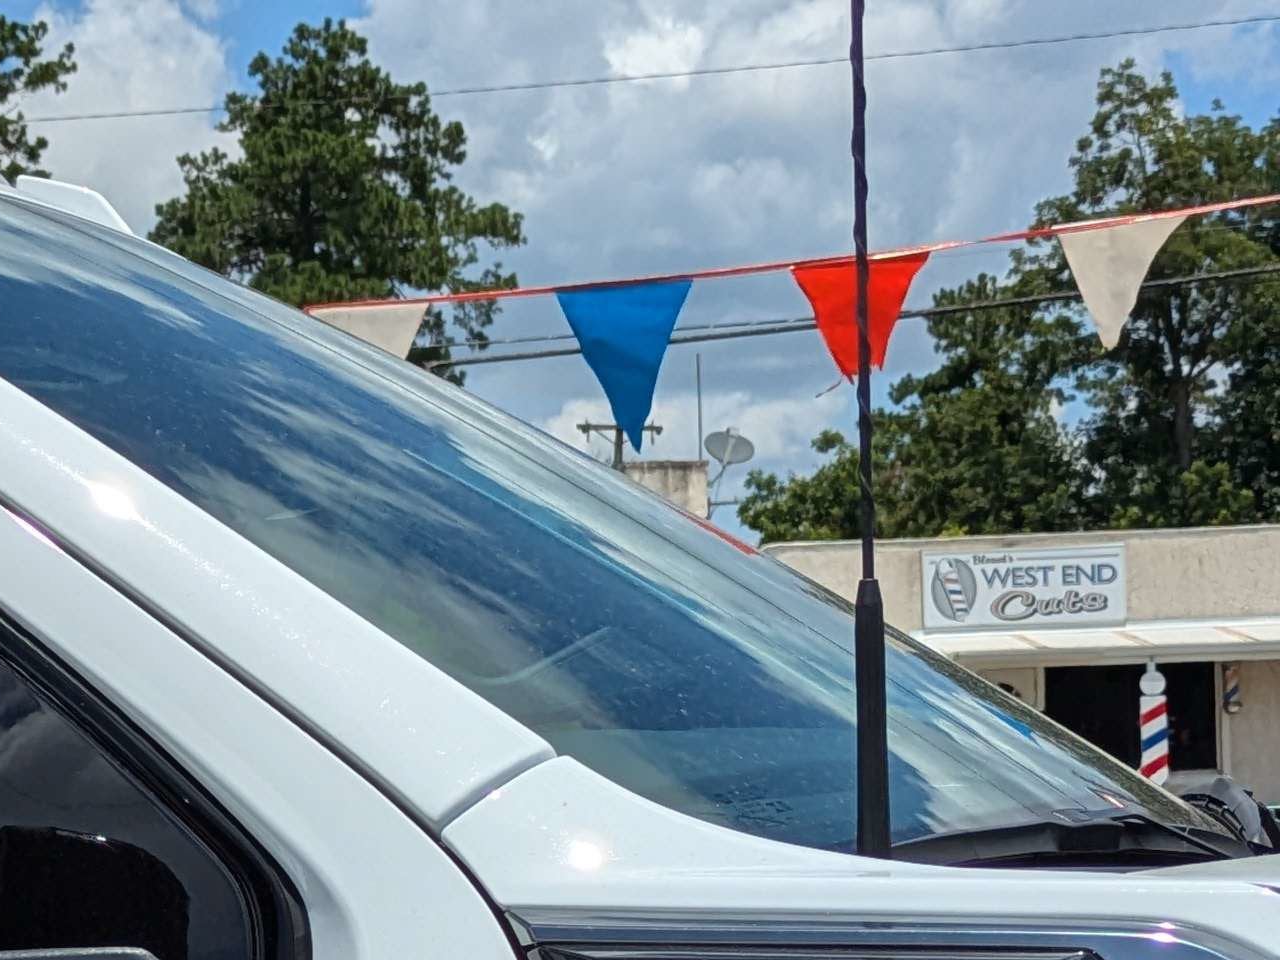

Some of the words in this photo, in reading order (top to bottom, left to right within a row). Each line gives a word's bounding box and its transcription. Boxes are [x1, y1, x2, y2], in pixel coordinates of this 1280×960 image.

[981, 564, 1055, 588] WEST
[1062, 563, 1118, 585] END
[990, 589, 1108, 621] Cuts
